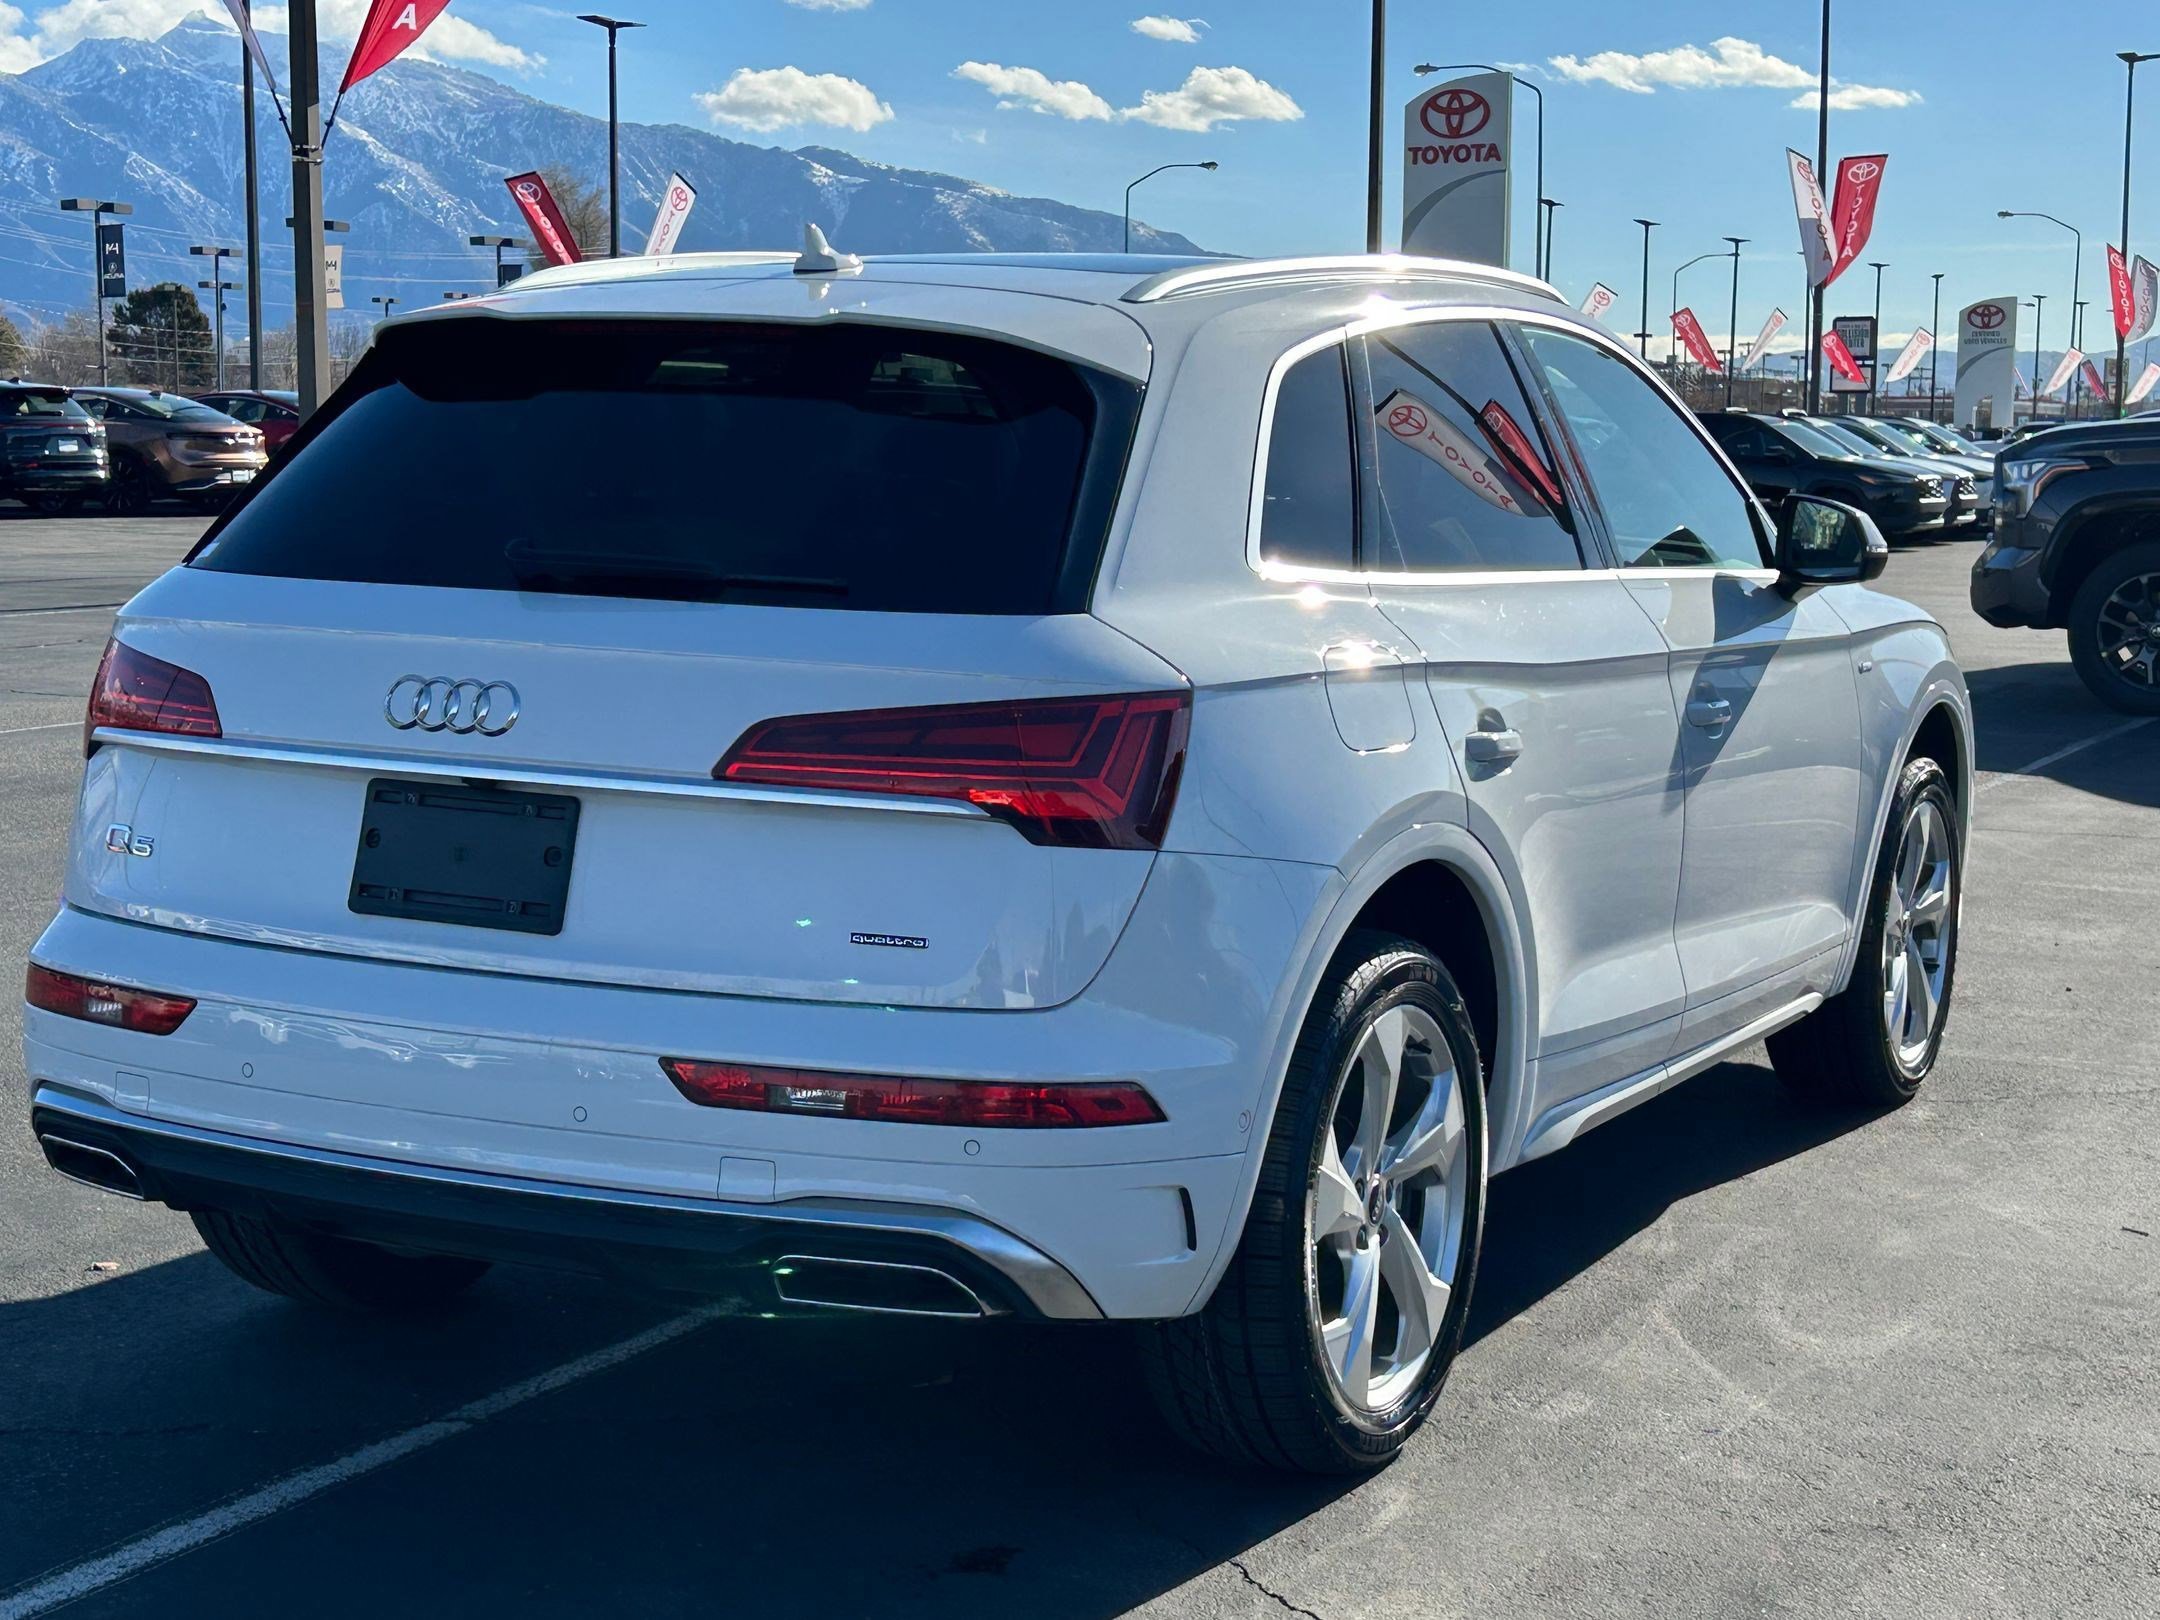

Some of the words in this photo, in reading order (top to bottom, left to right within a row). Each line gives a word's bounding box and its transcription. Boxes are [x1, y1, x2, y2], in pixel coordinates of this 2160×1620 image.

[1407, 142, 1503, 166] TOYOTA
[1841, 184, 1865, 258] TOYOTA
[2117, 269, 2132, 328] TOYOTA
[105, 822, 155, 857] Q5
[852, 934, 925, 947] quattro
